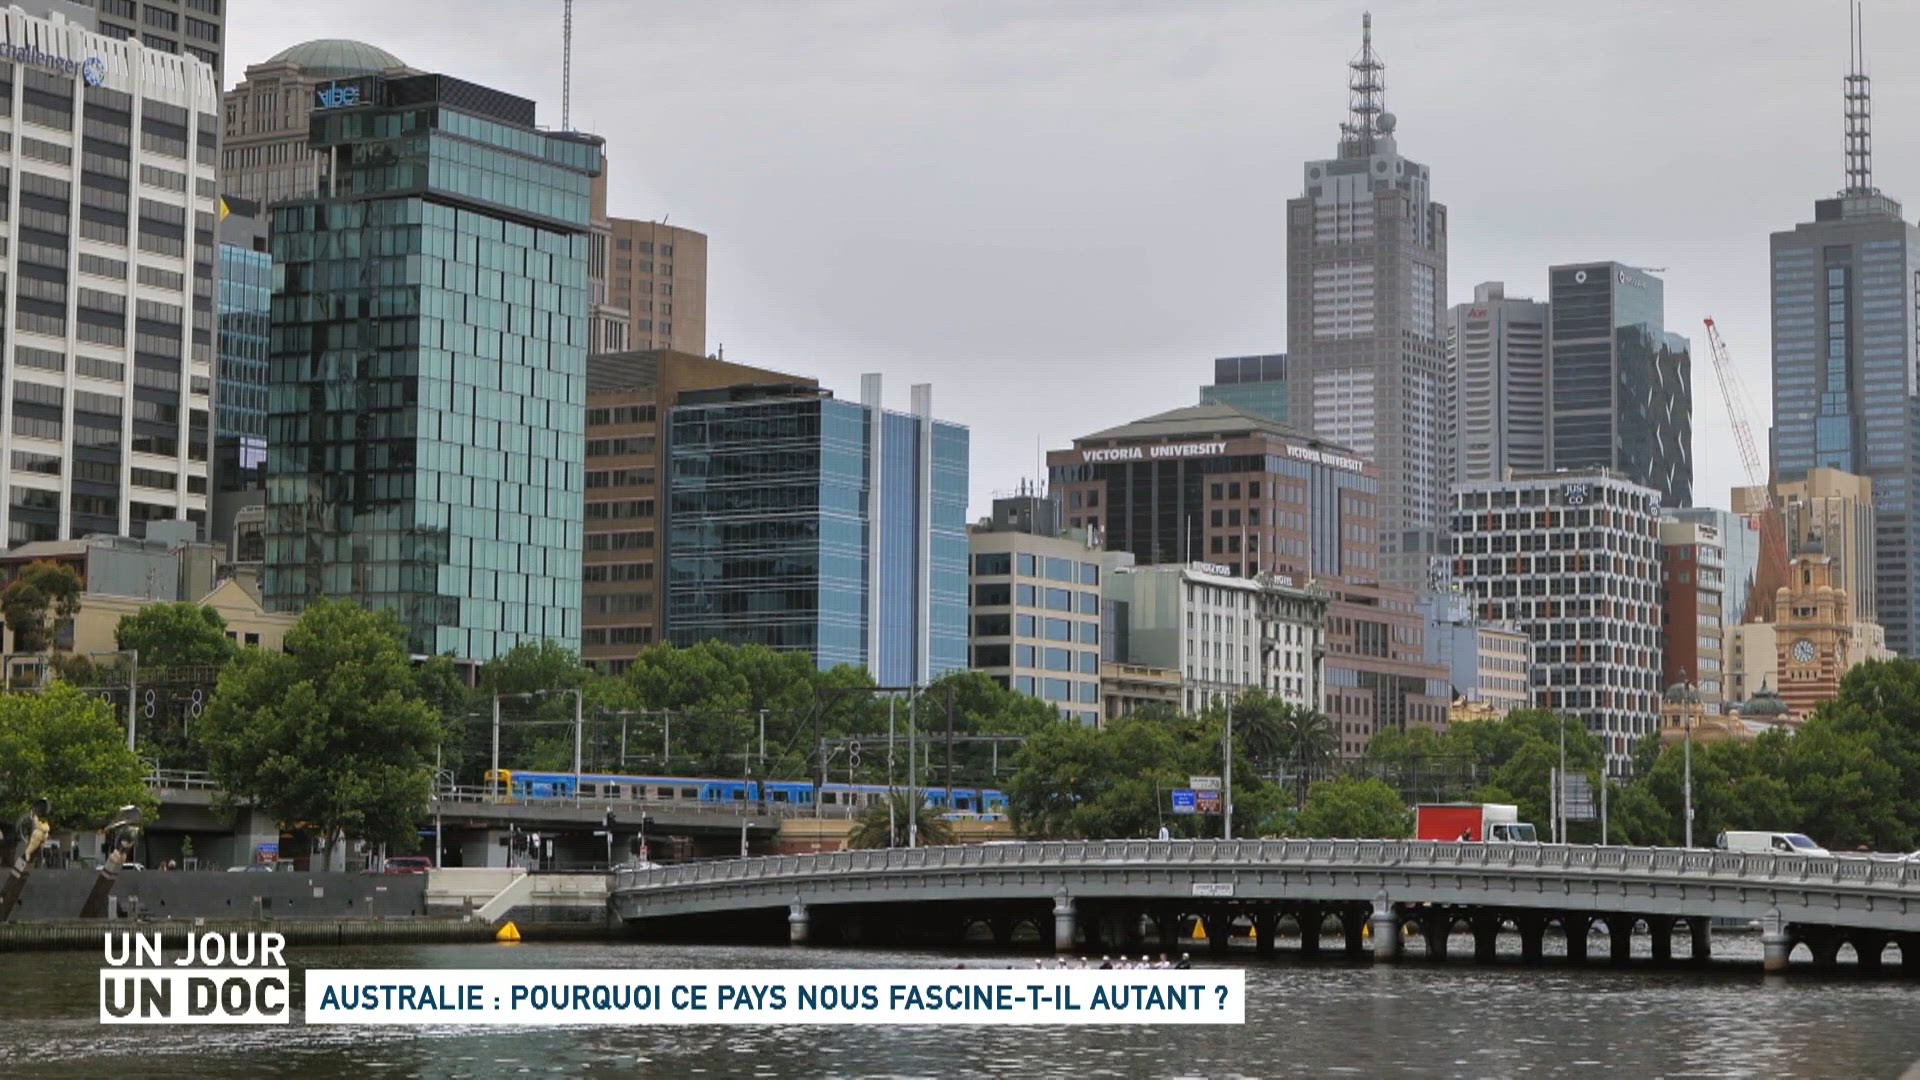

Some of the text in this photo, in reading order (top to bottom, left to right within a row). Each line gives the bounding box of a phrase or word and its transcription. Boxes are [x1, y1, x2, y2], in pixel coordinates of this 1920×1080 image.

[0, 42, 81, 76] challenger
[1082, 442, 1227, 462] VICTORIA UNIVERSITY
[1286, 444, 1363, 472] VICTORIA UNIVERSITY
[1273, 575, 1293, 586] HOTEL
